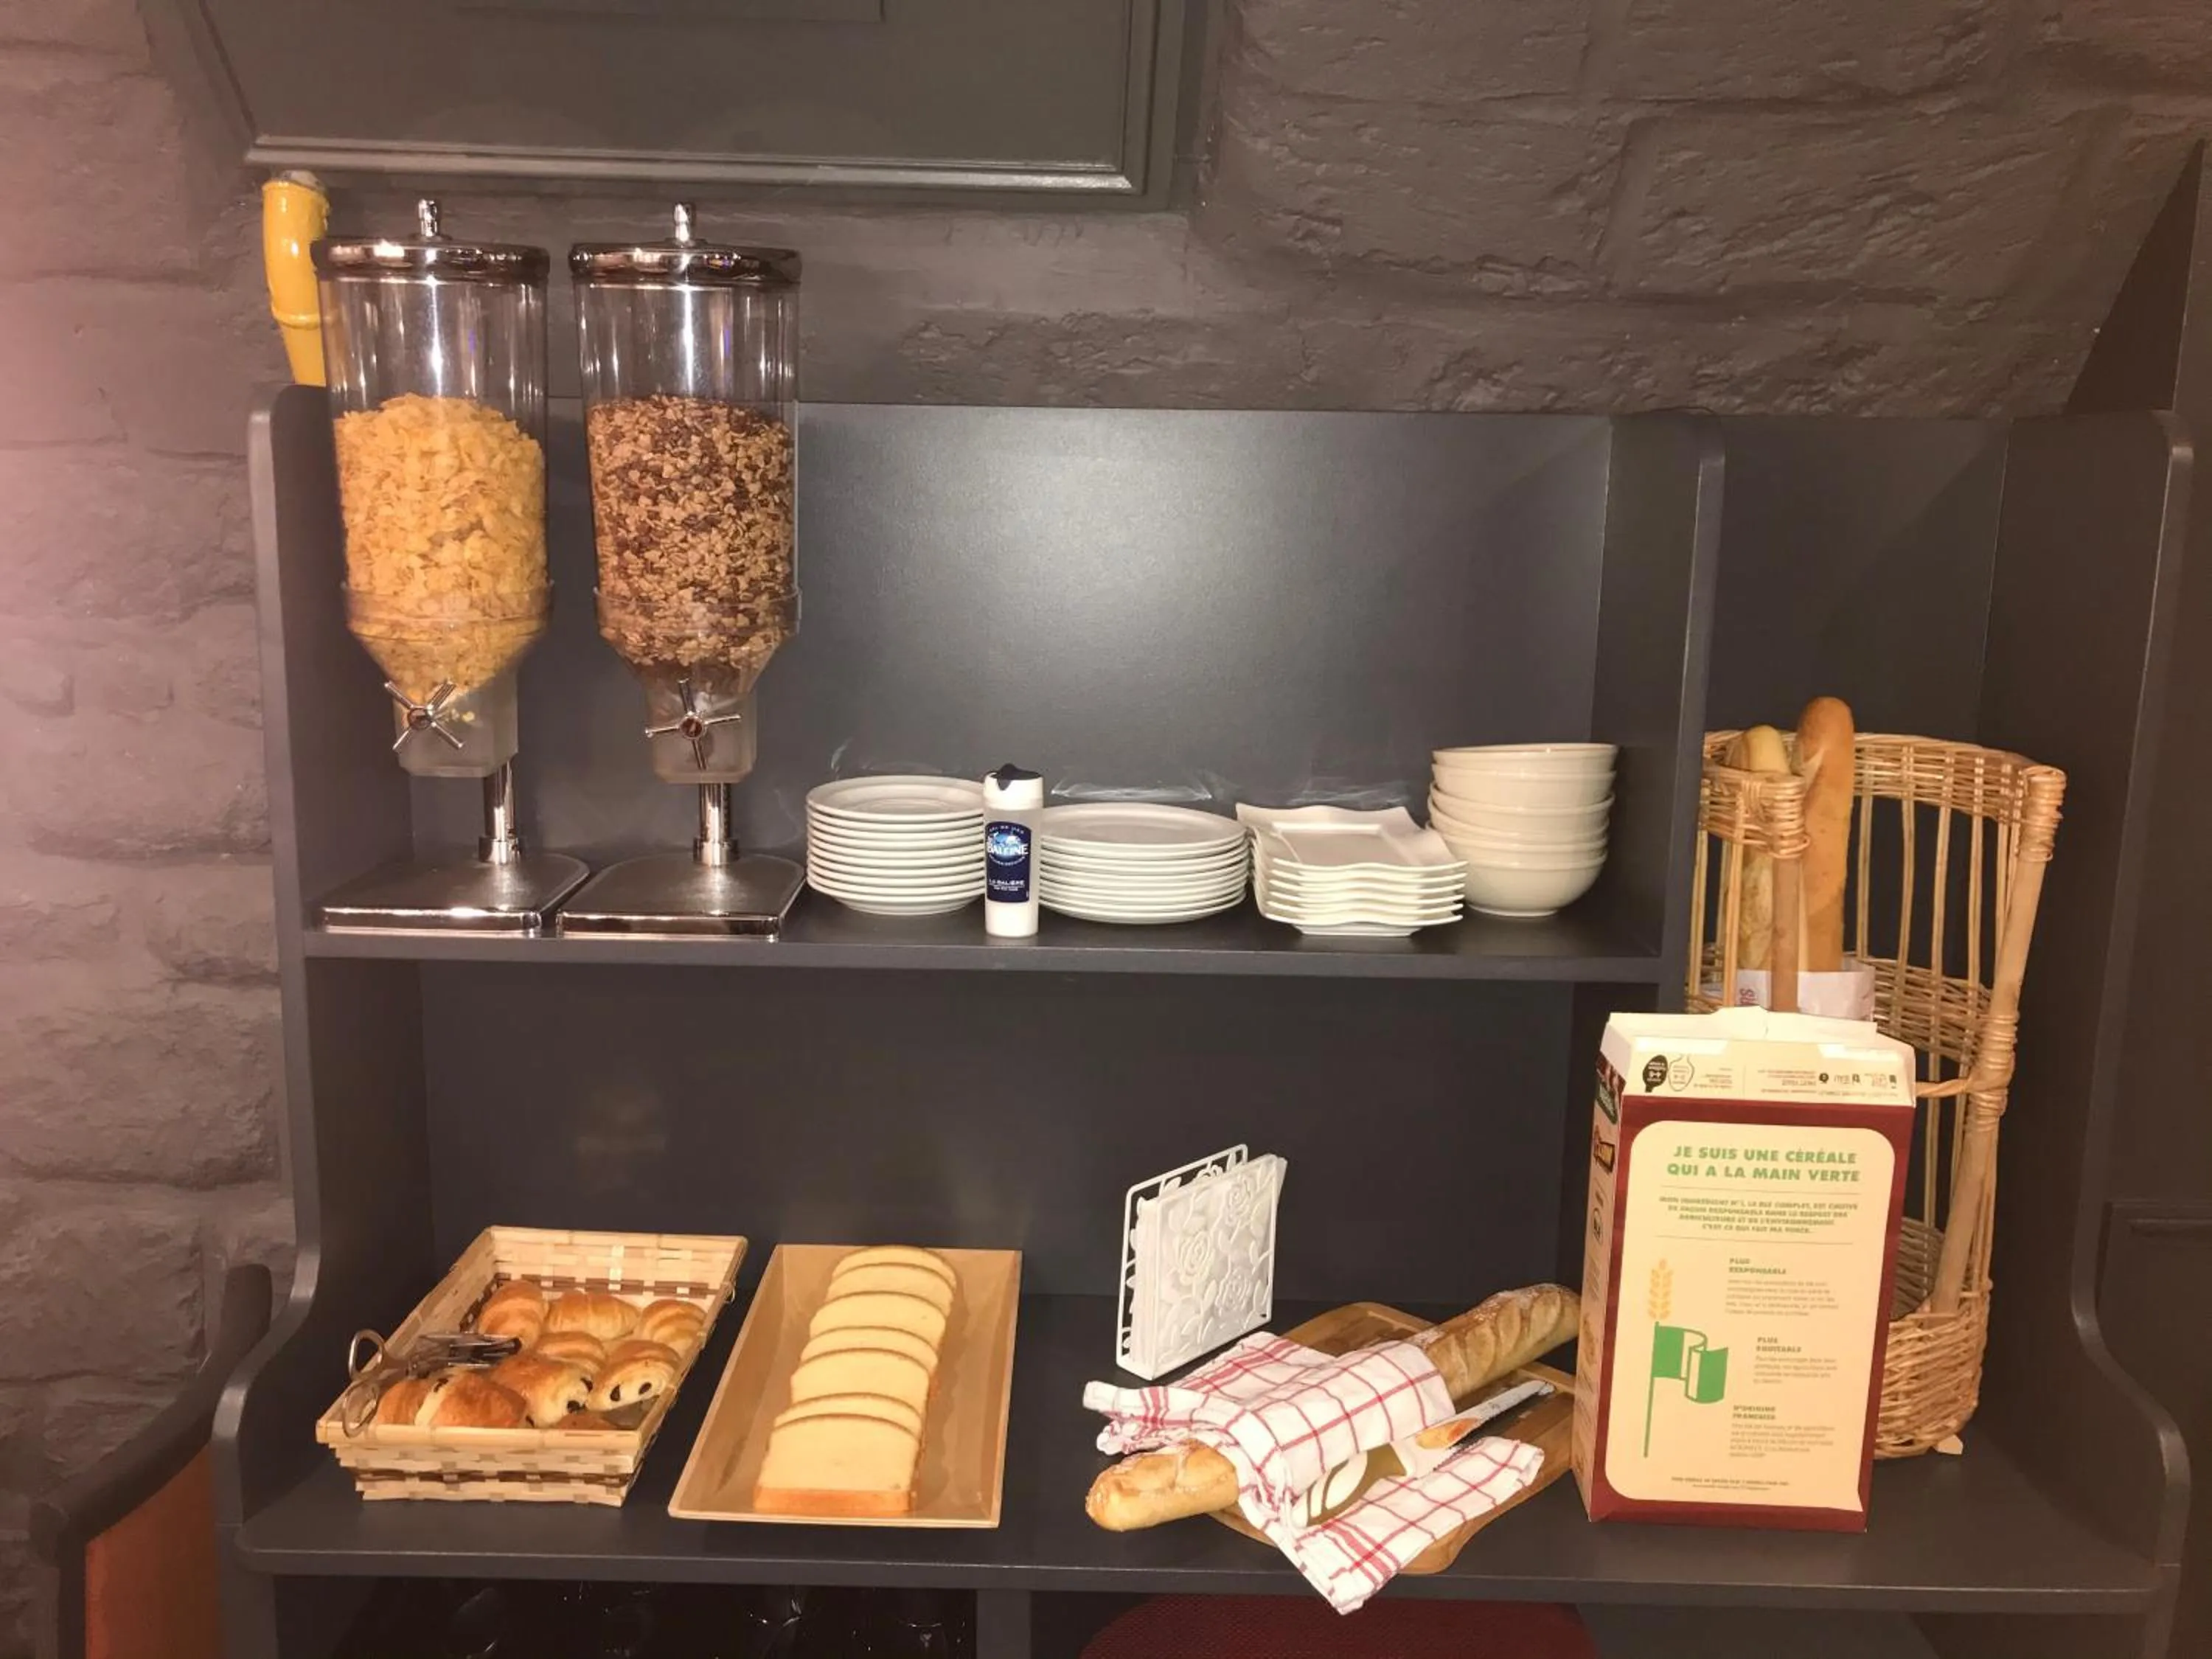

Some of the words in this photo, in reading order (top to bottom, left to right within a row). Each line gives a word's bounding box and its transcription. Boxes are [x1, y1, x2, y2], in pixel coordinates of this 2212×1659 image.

[1674, 1146, 1693, 1158] JE
[1698, 1147, 1738, 1160] SUIS
[1744, 1149, 1778, 1161] UNE
[1785, 1148, 1857, 1164] CÉRÉALE
[1667, 1163, 1698, 1176] QUI
[1705, 1166, 1717, 1177] A
[1724, 1166, 1746, 1178] LA
[1753, 1167, 1801, 1180] MAIN
[1808, 1169, 1860, 1182] VERTE
